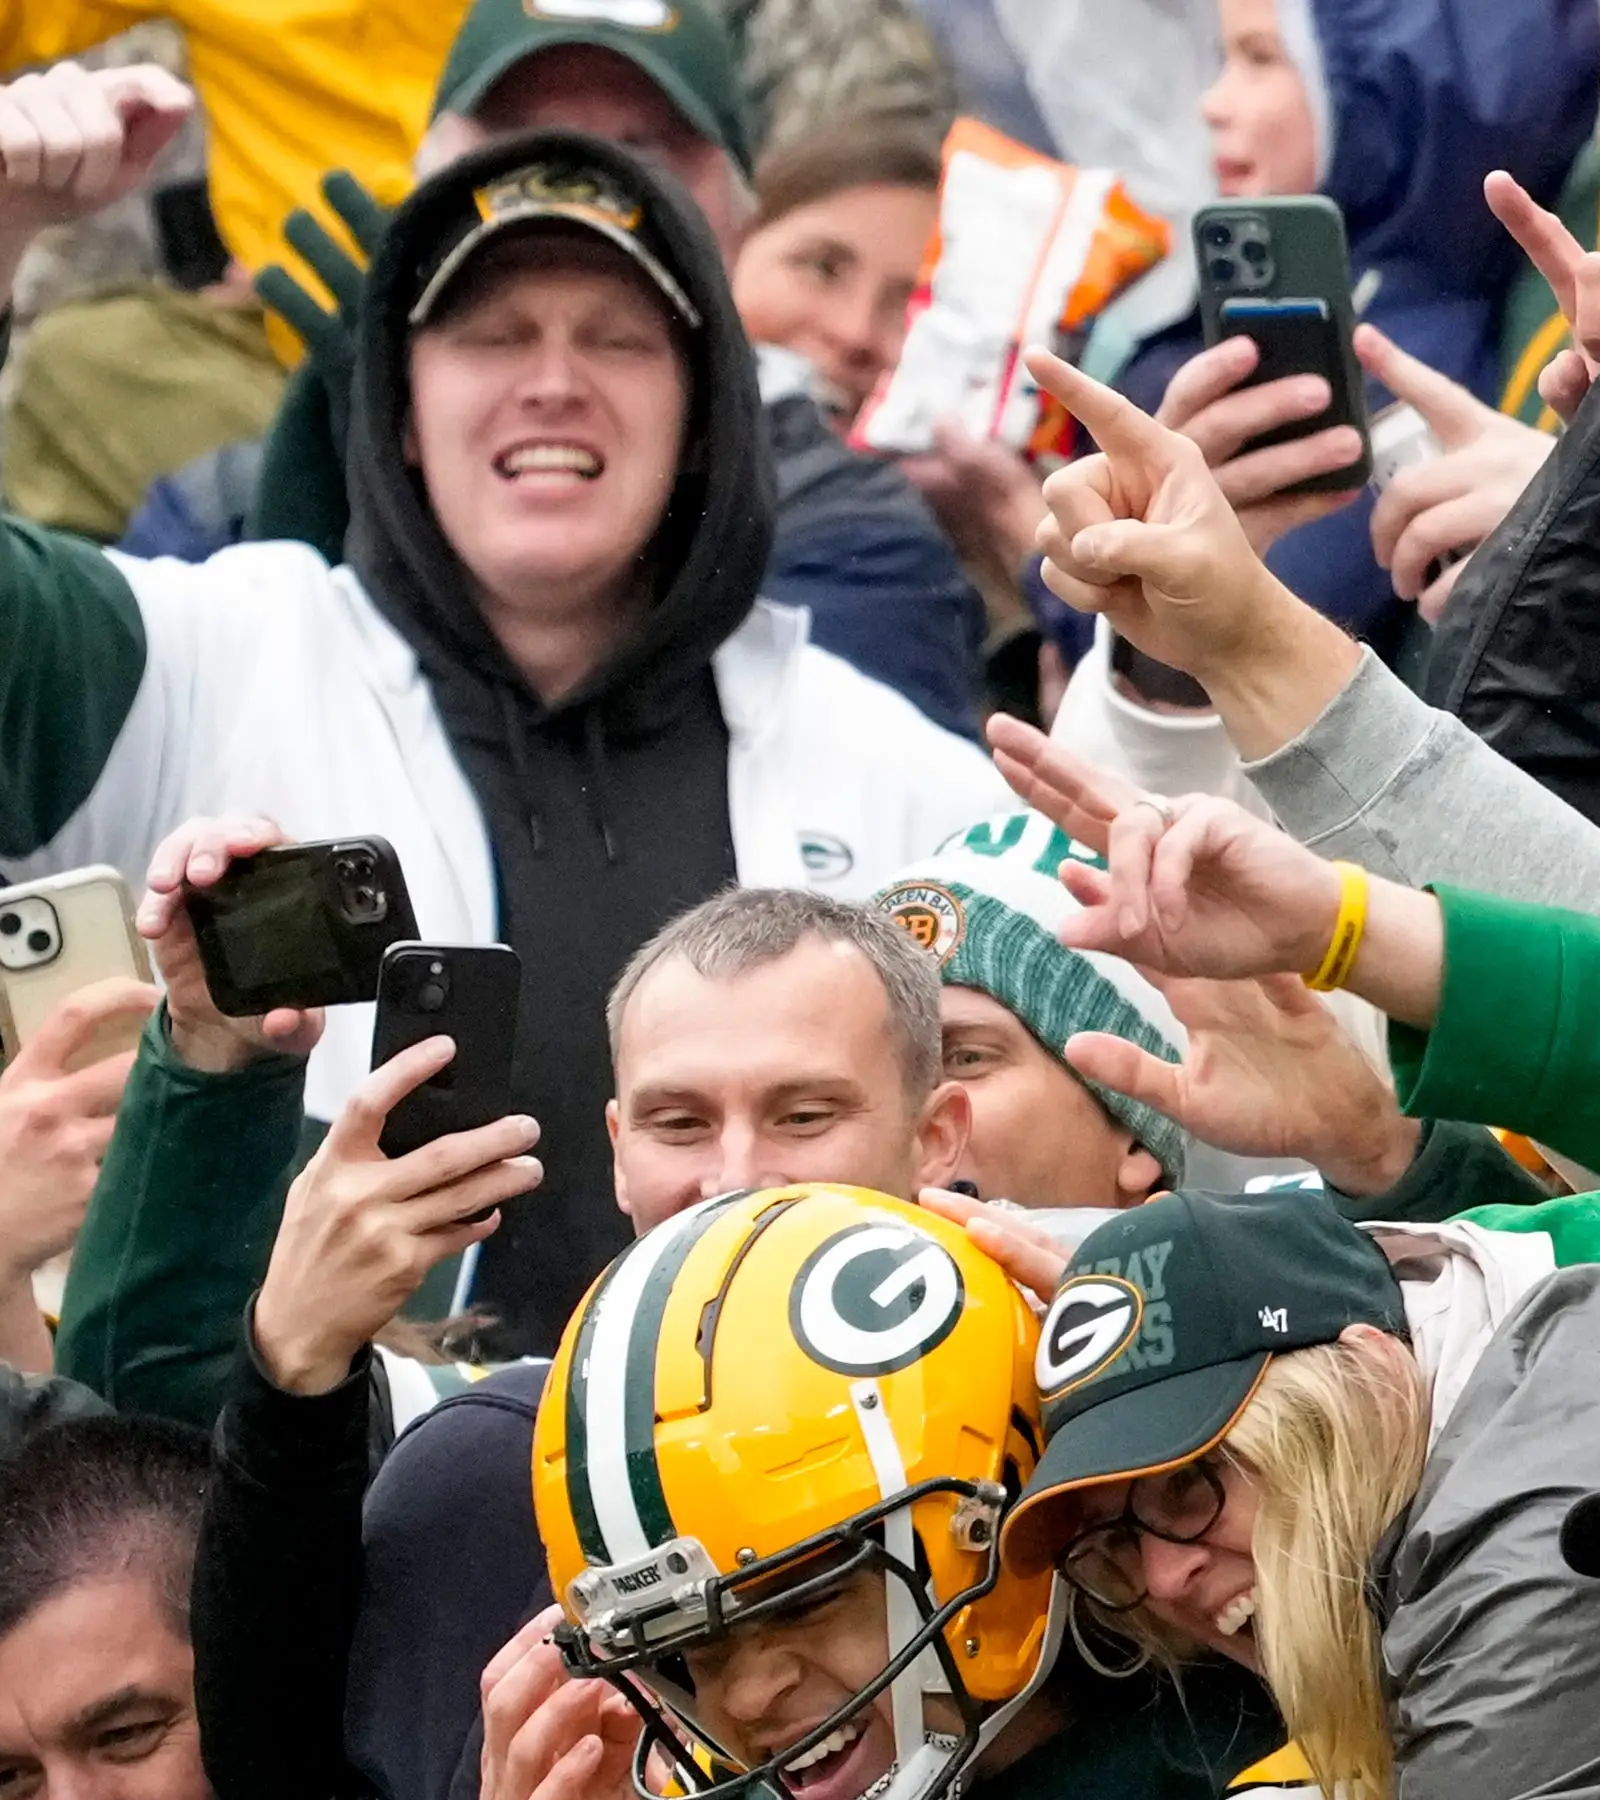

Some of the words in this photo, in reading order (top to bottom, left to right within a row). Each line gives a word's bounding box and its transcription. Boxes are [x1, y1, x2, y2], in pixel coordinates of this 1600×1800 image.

[885, 890, 929, 914] REEN
[931, 893, 954, 917] BAY
[789, 1222, 965, 1377] G
[1036, 1275, 1142, 1402] G
[611, 1562, 661, 1594] PACKER
